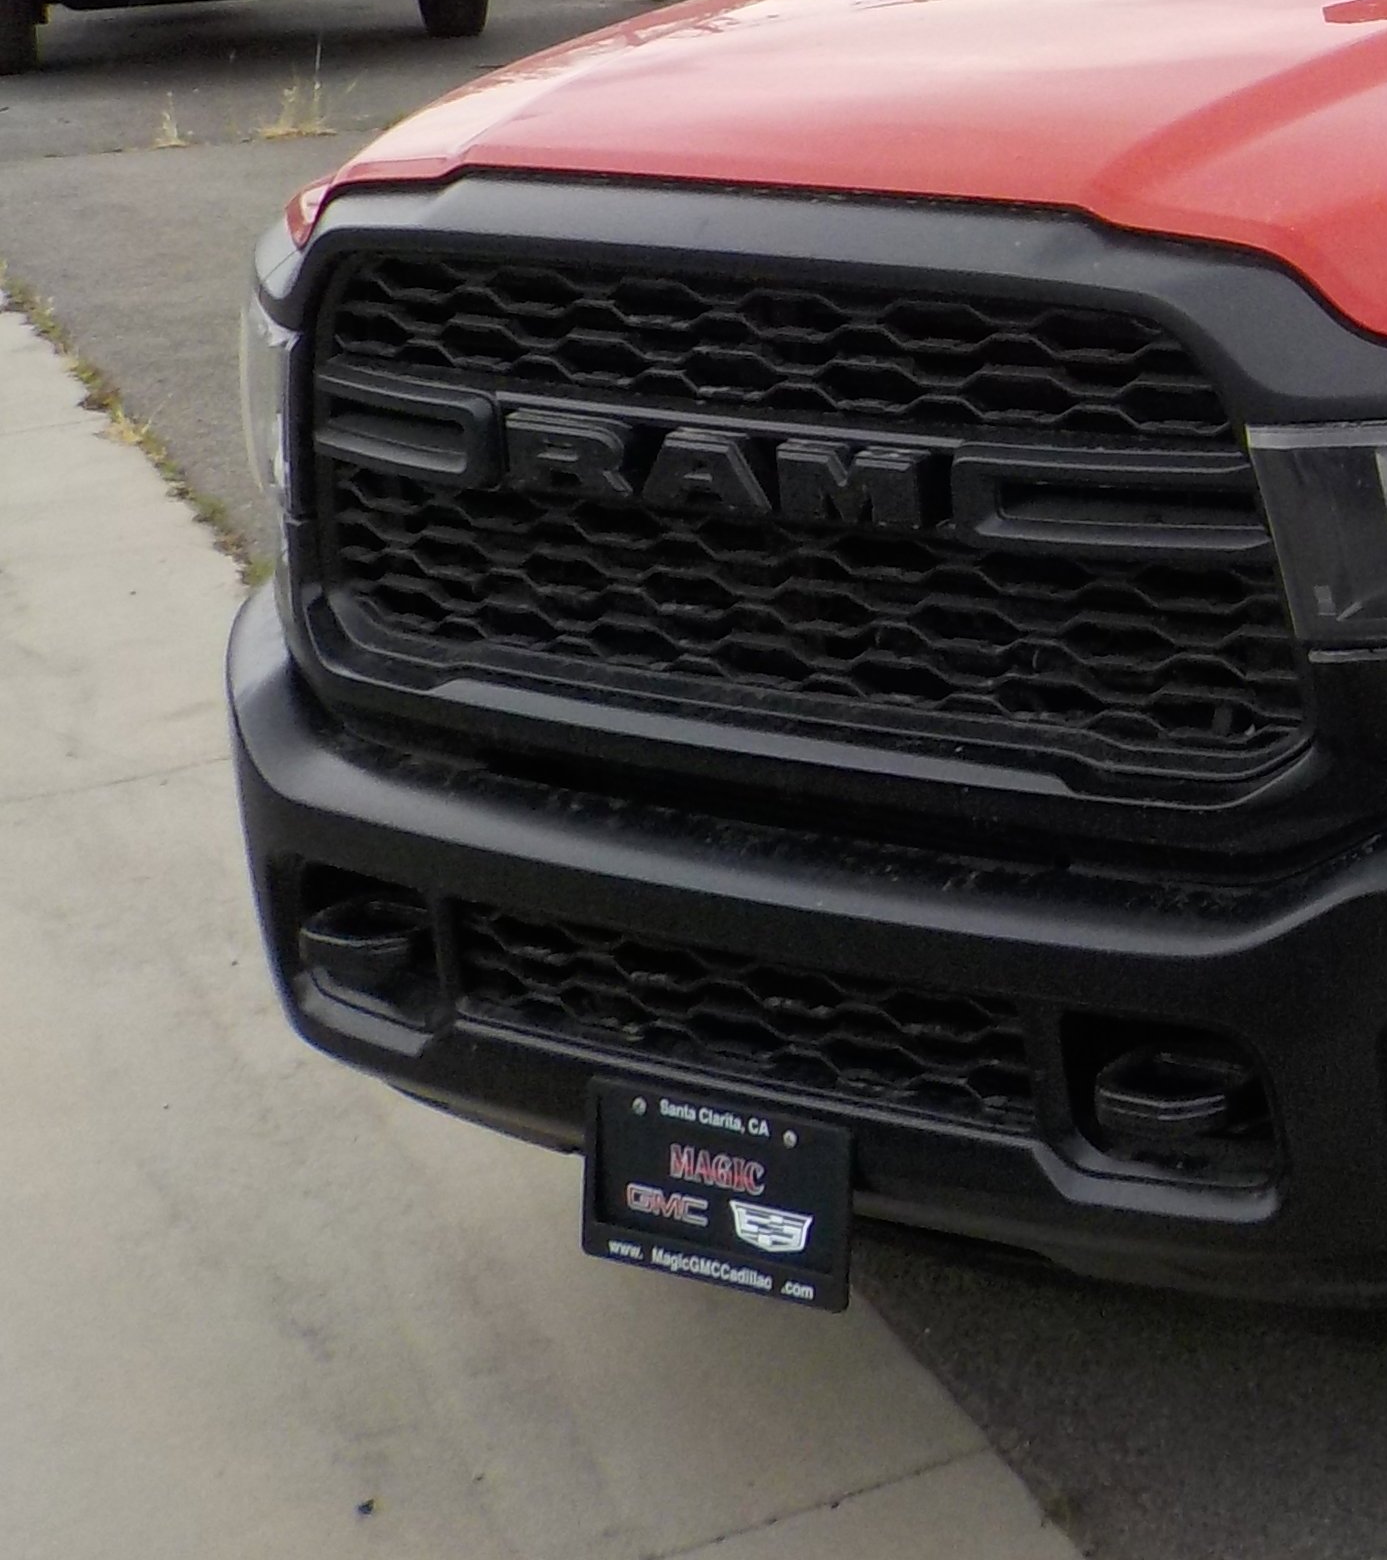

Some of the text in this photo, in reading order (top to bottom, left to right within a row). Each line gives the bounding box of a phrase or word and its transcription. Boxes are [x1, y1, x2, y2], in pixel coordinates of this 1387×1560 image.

[505, 409, 925, 528] RAM
[660, 1099, 770, 1137] Santa Clarita, CA
[670, 1143, 765, 1195] MAGIC
[627, 1183, 709, 1227] GMC
